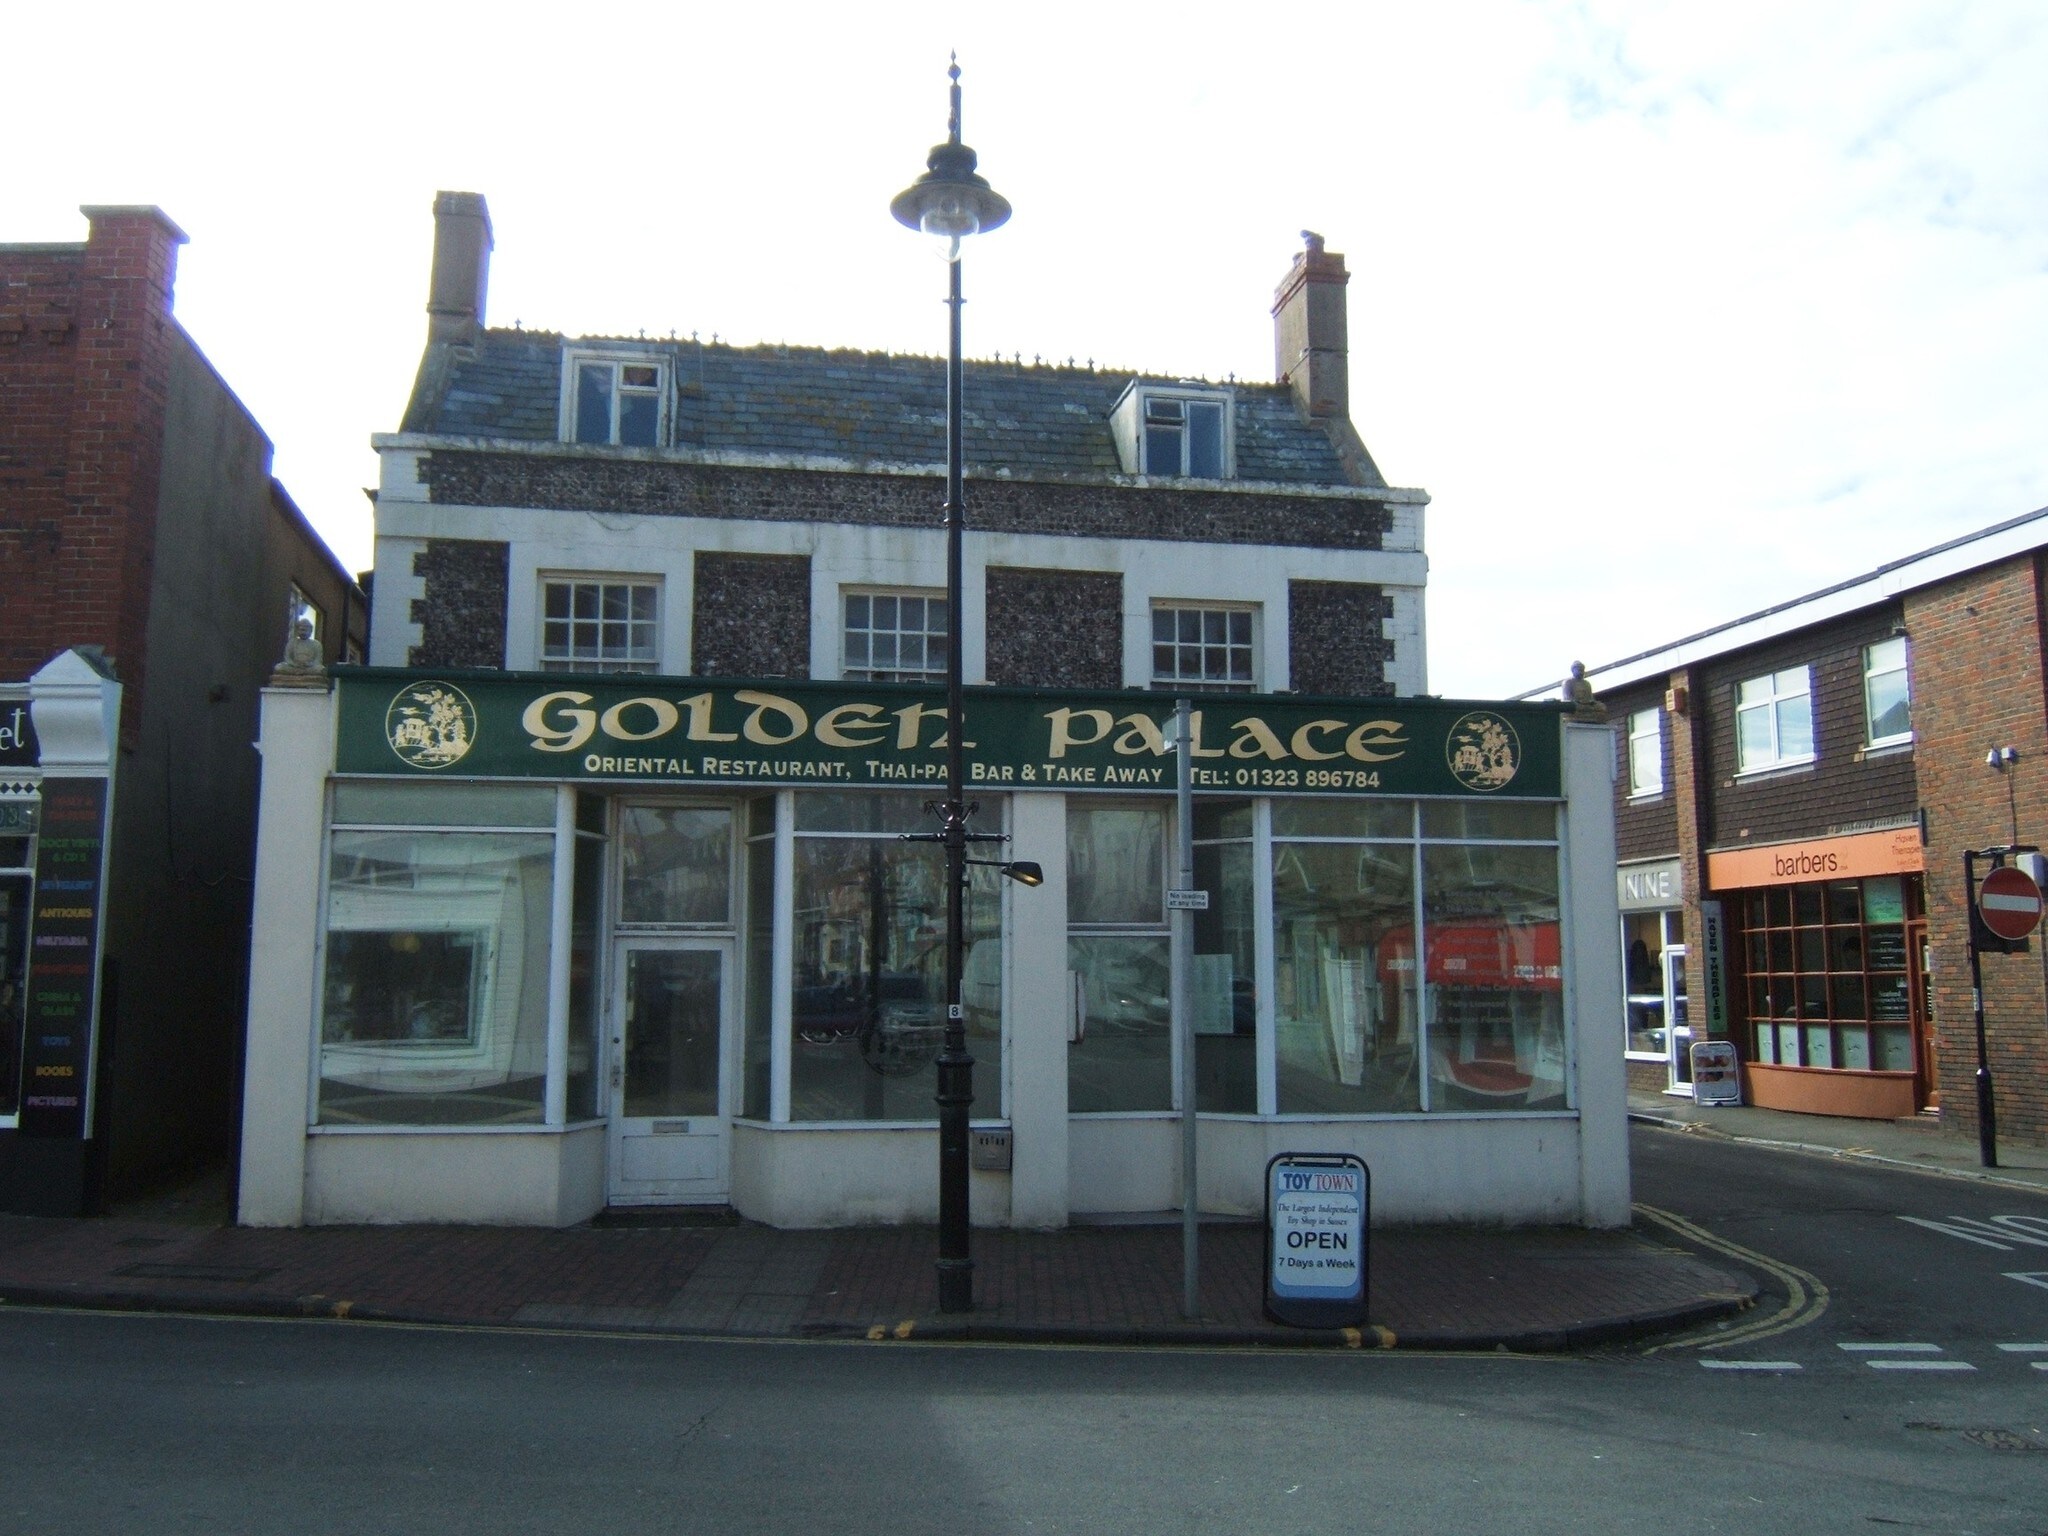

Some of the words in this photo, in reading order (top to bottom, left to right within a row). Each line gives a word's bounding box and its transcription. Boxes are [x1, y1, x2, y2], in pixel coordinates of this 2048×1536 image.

[585, 754, 694, 774] ORIENTAL
[703, 757, 851, 780] RESTAURANT,
[866, 760, 949, 779] THAI-PA
[971, 763, 1014, 780] BAR
[1021, 764, 1036, 781] &
[1043, 764, 1096, 782] TAKE
[1104, 766, 1163, 783] AWAY
[1236, 769, 1299, 786] 01323
[1305, 770, 1380, 788] 896784
[1775, 850, 1838, 877] barbers
[1625, 871, 1670, 899] NINE
[39, 908, 93, 918] ANTIQUES
[951, 1006, 959, 1017] 8
[36, 1065, 74, 1076] BOOKS
[27, 1095, 78, 1106] PICTURES
[1283, 1173, 1312, 1190] TOY
[1314, 1174, 1353, 1191] TOWN
[1278, 1203, 1290, 1212] The
[1292, 1204, 1315, 1215] Largest
[1318, 1204, 1358, 1216] Independent
[1287, 1231, 1347, 1249] OPEN
[1278, 1256, 1285, 1267] 7
[1288, 1257, 1314, 1269] Days
[1317, 1259, 1324, 1268] a
[1325, 1258, 1356, 1269] Week
